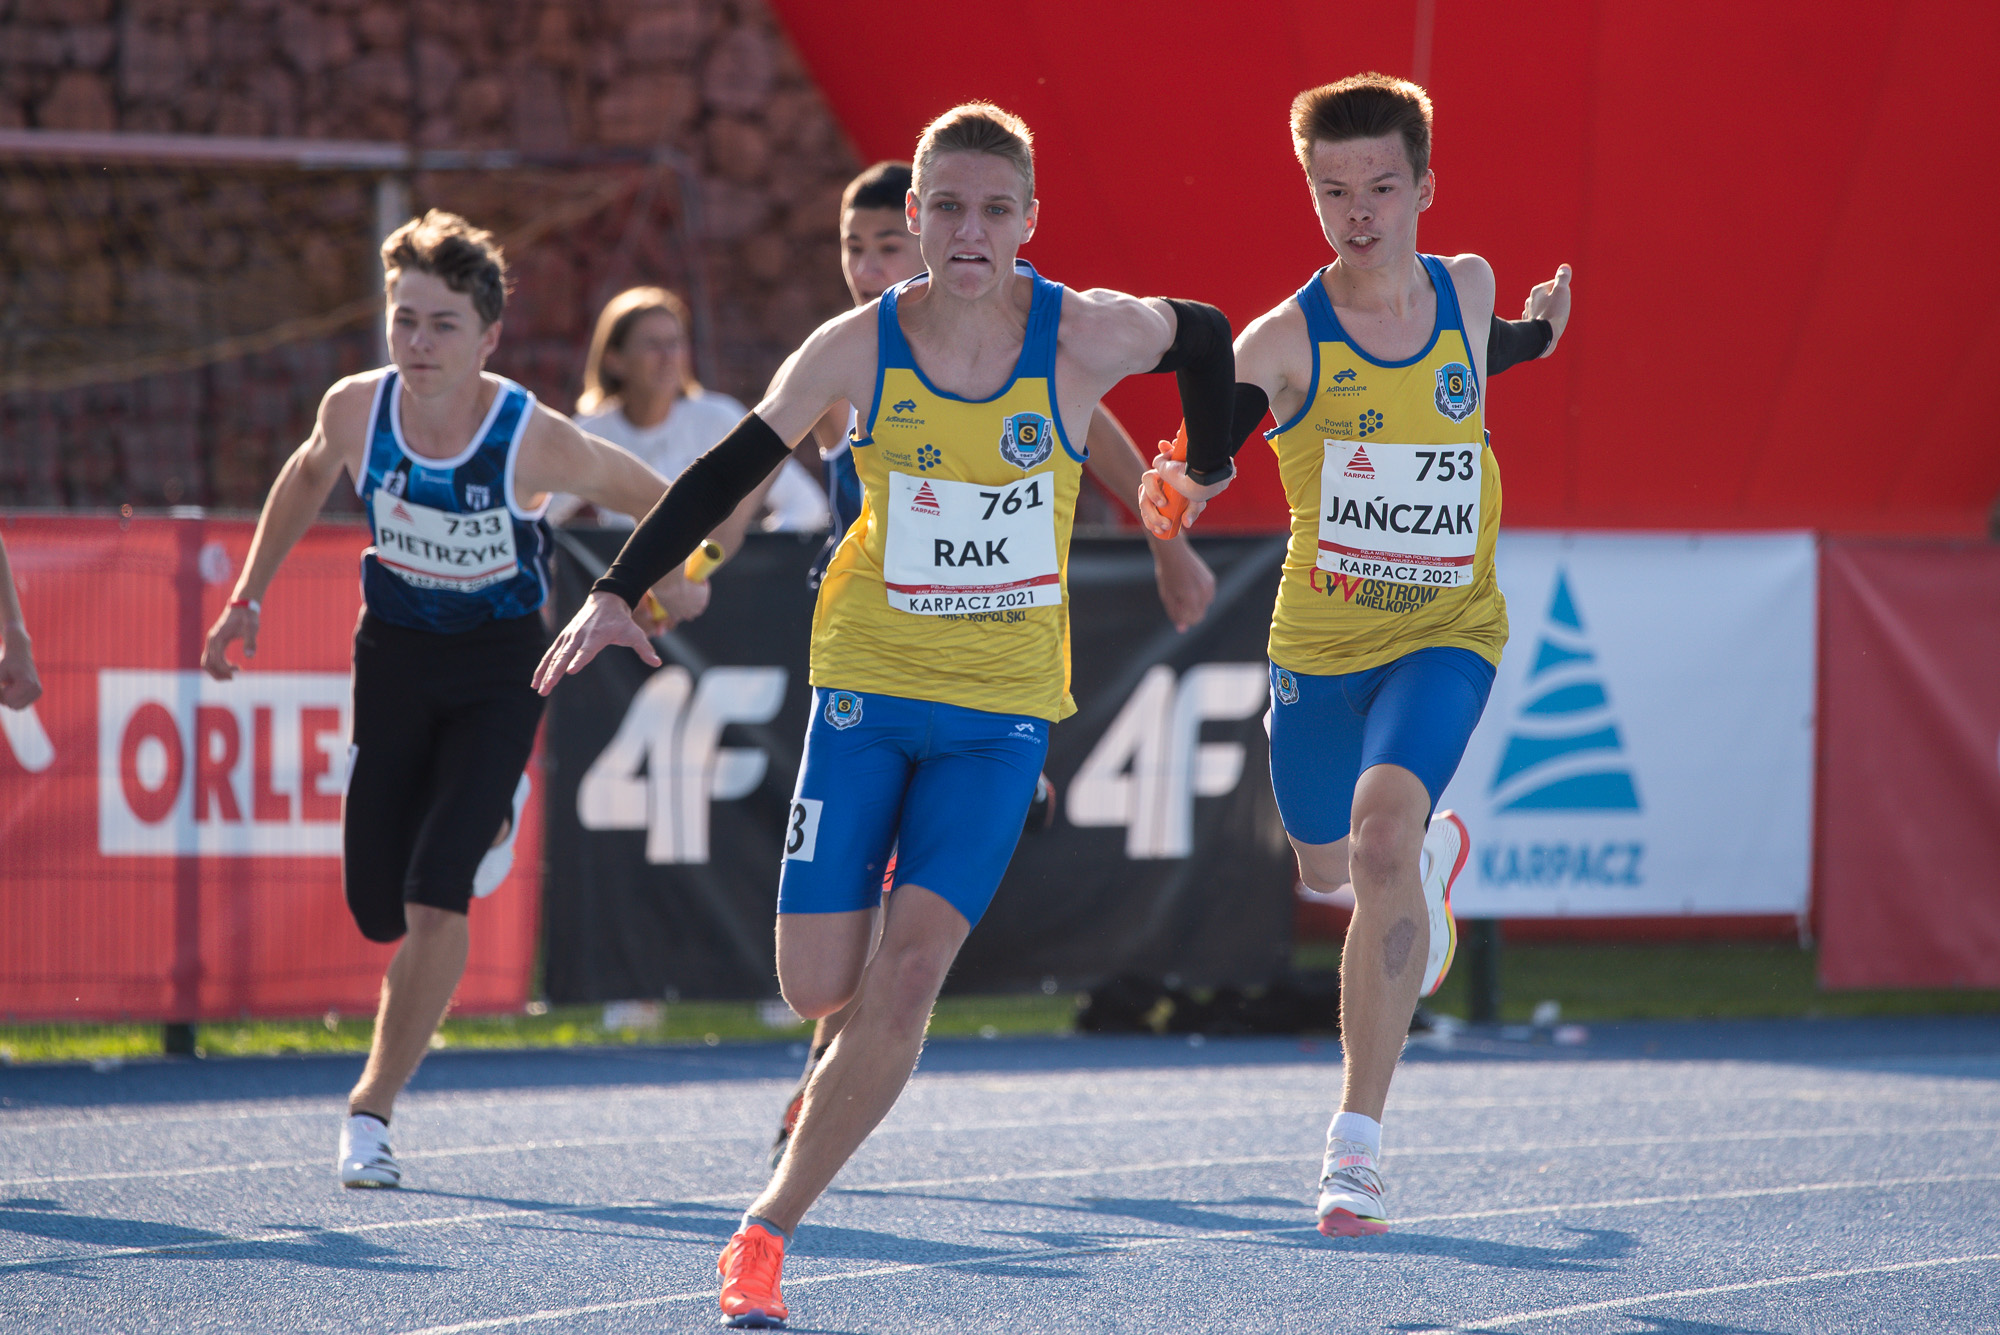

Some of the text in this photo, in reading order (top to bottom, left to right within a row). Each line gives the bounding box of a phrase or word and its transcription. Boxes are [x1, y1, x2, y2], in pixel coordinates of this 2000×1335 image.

[1452, 377, 1461, 391] S
[1022, 428, 1034, 441] S
[1315, 424, 1353, 436] Ostrowski
[1325, 418, 1353, 428] Powiat
[1343, 471, 1376, 480] KARPACZ
[1415, 450, 1474, 482] 753
[910, 506, 941, 517] KARPACZ
[979, 481, 1044, 521] 761
[444, 515, 503, 538] 733
[1327, 495, 1475, 535] JAŃCZAK
[379, 527, 510, 566] PIETRZYK
[933, 536, 1011, 567] RAK
[1339, 557, 1459, 584] KARPACZ 2021
[909, 590, 1036, 612] KARPACZ 2021
[840, 701, 849, 710] S
[576, 663, 789, 865] 4F
[1065, 661, 1270, 860] 4F
[786, 803, 807, 855] 3
[1477, 841, 1646, 888] KARPACZ
[1338, 1154, 1373, 1169] NIKE
